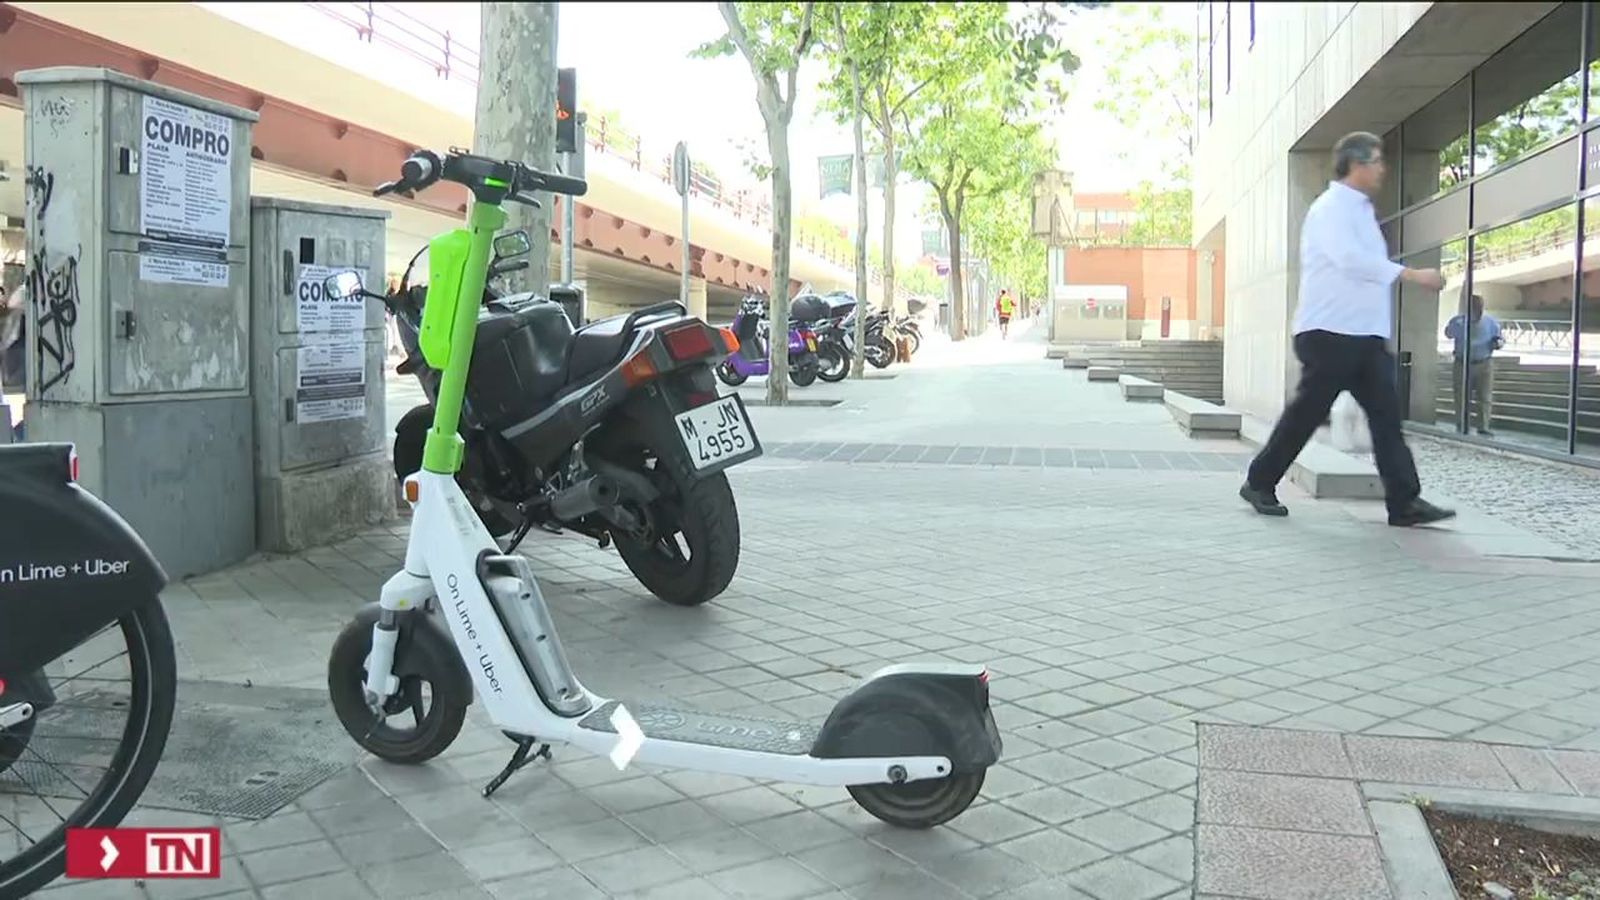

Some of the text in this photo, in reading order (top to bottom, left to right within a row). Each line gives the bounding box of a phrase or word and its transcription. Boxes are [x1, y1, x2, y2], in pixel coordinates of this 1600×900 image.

[145, 115, 230, 157] COMPRO
[680, 416, 698, 440] M
[717, 402, 739, 428] JN
[698, 426, 745, 461] 4955
[0, 559, 130, 583] n Lime + Uber
[446, 573, 503, 694] On Lime + Uber
